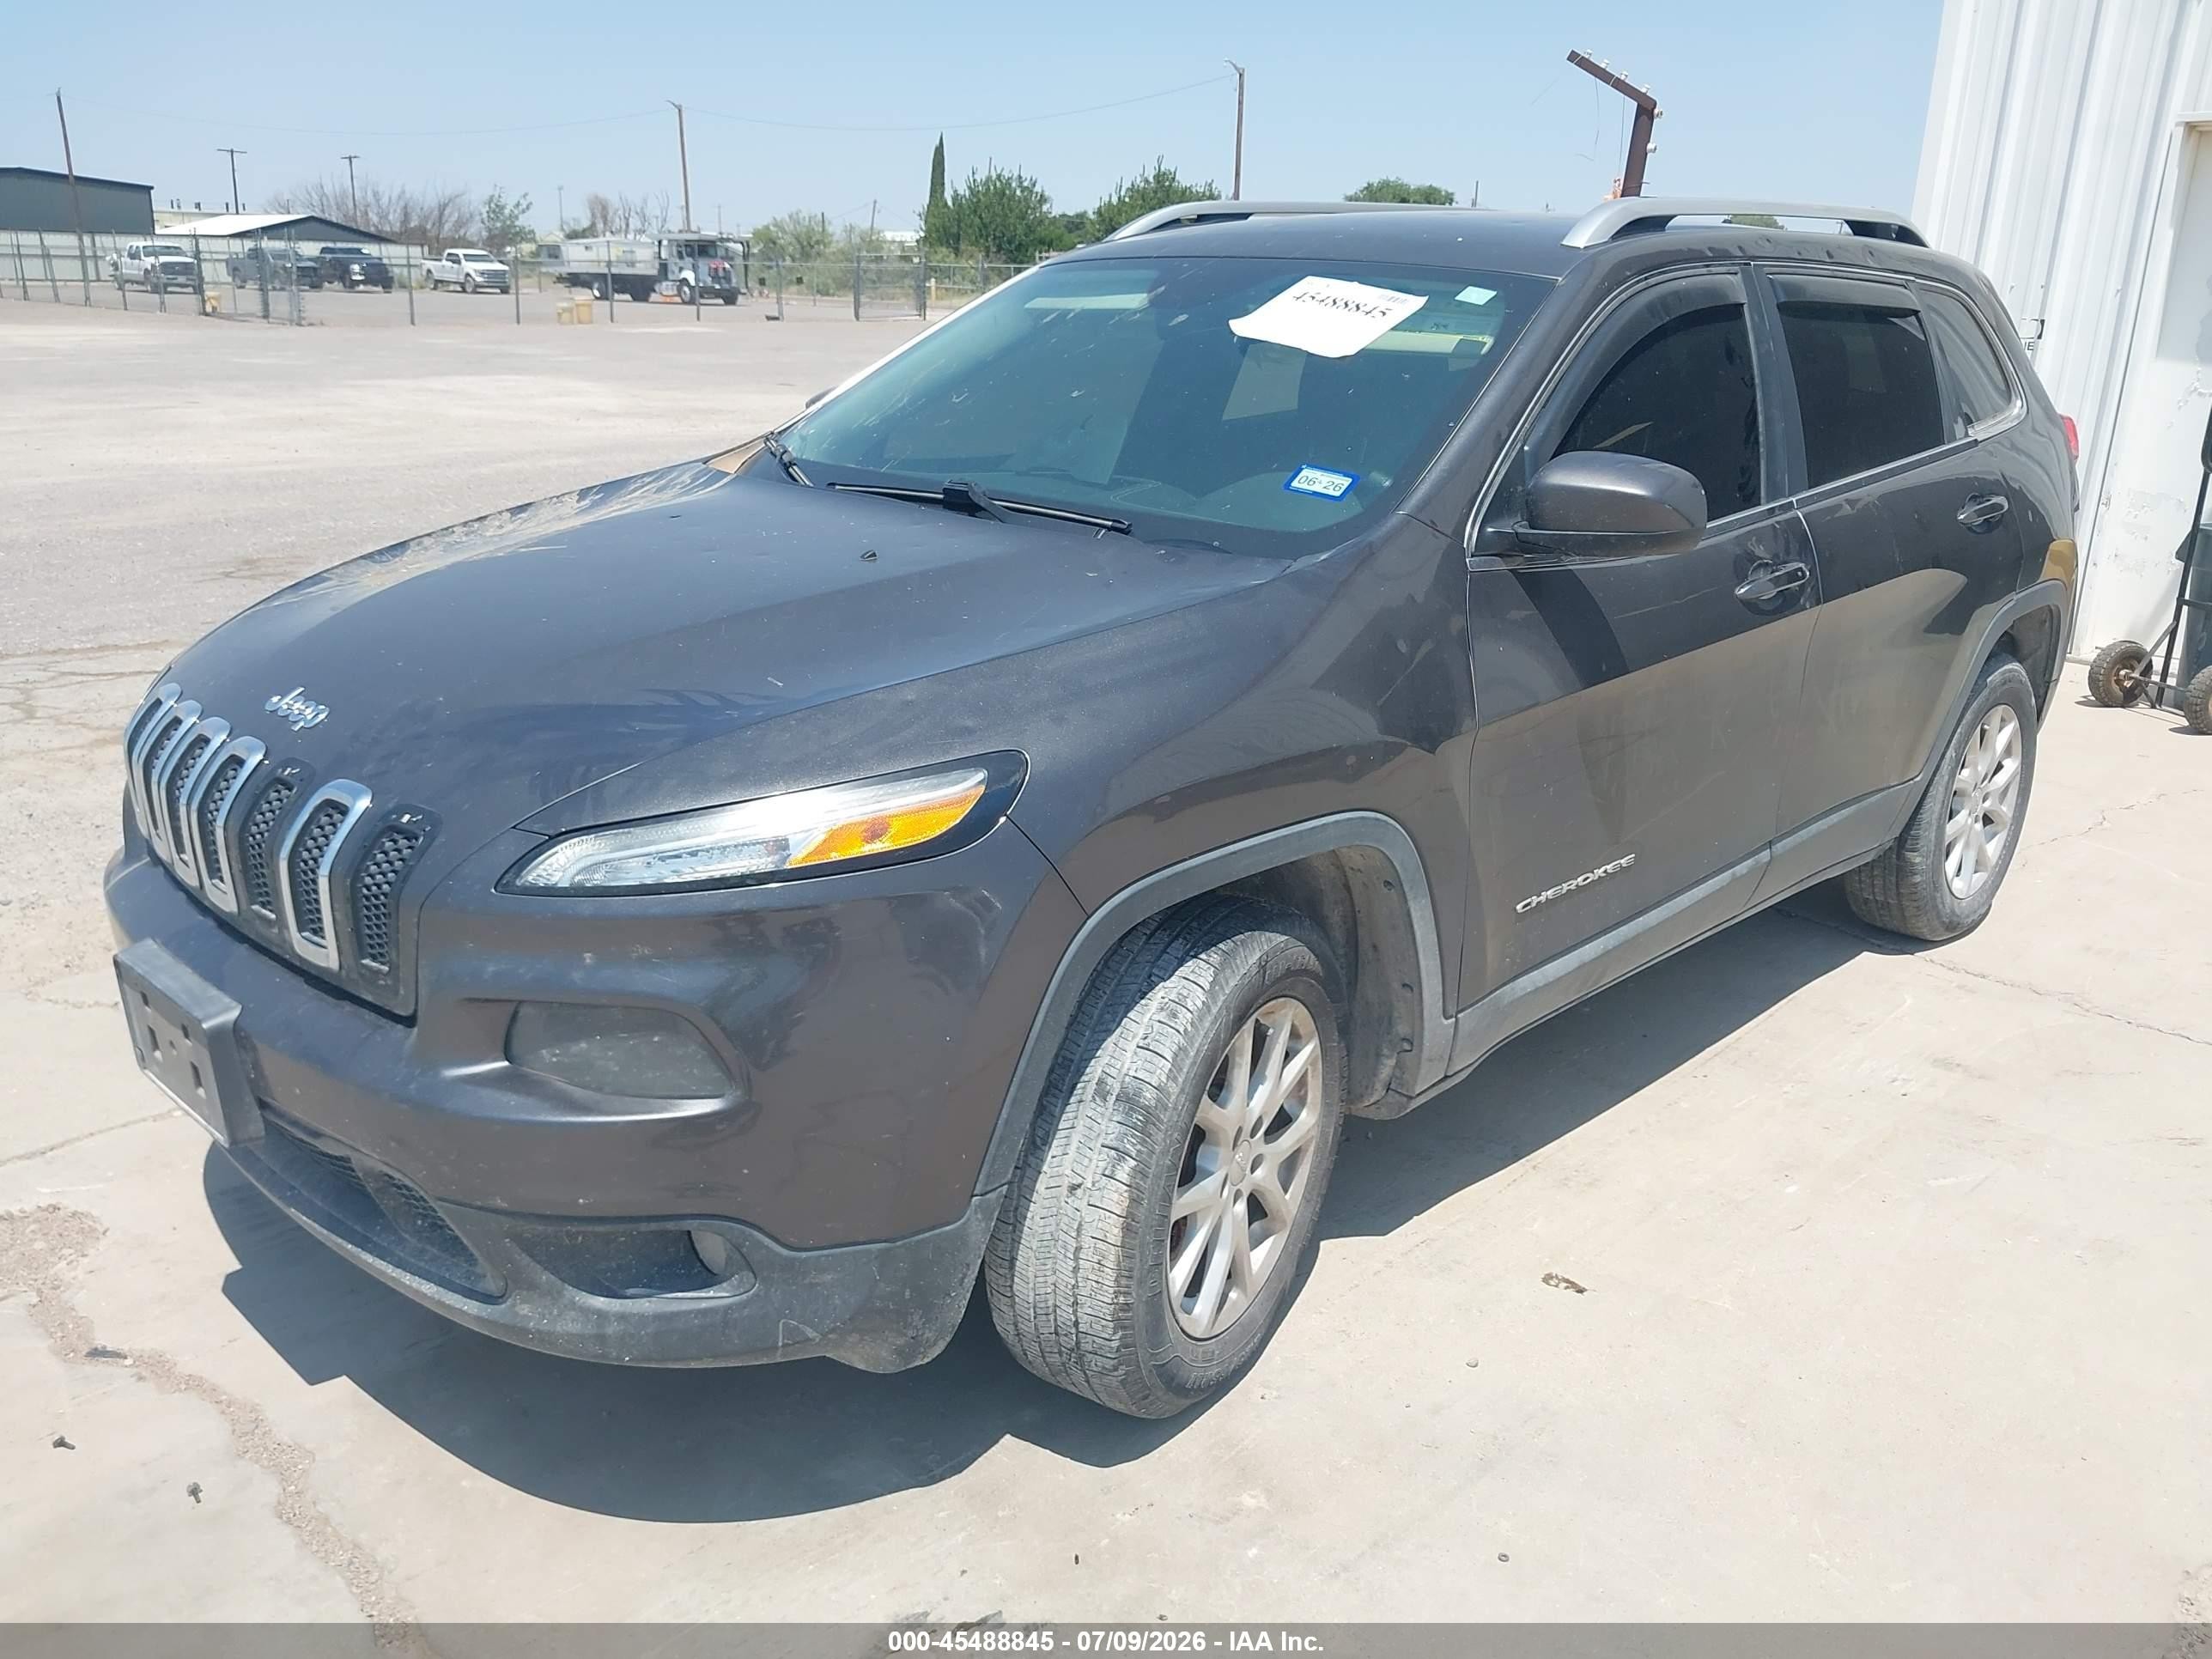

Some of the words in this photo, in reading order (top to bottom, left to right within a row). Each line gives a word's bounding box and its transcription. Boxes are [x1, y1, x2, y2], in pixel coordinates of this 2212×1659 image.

[1292, 291, 1393, 319] 45488845
[1297, 475, 1319, 487] 06
[1322, 480, 1346, 492] 26
[264, 686, 330, 732] Jeep
[1515, 853, 1636, 914] CHEROKEE
